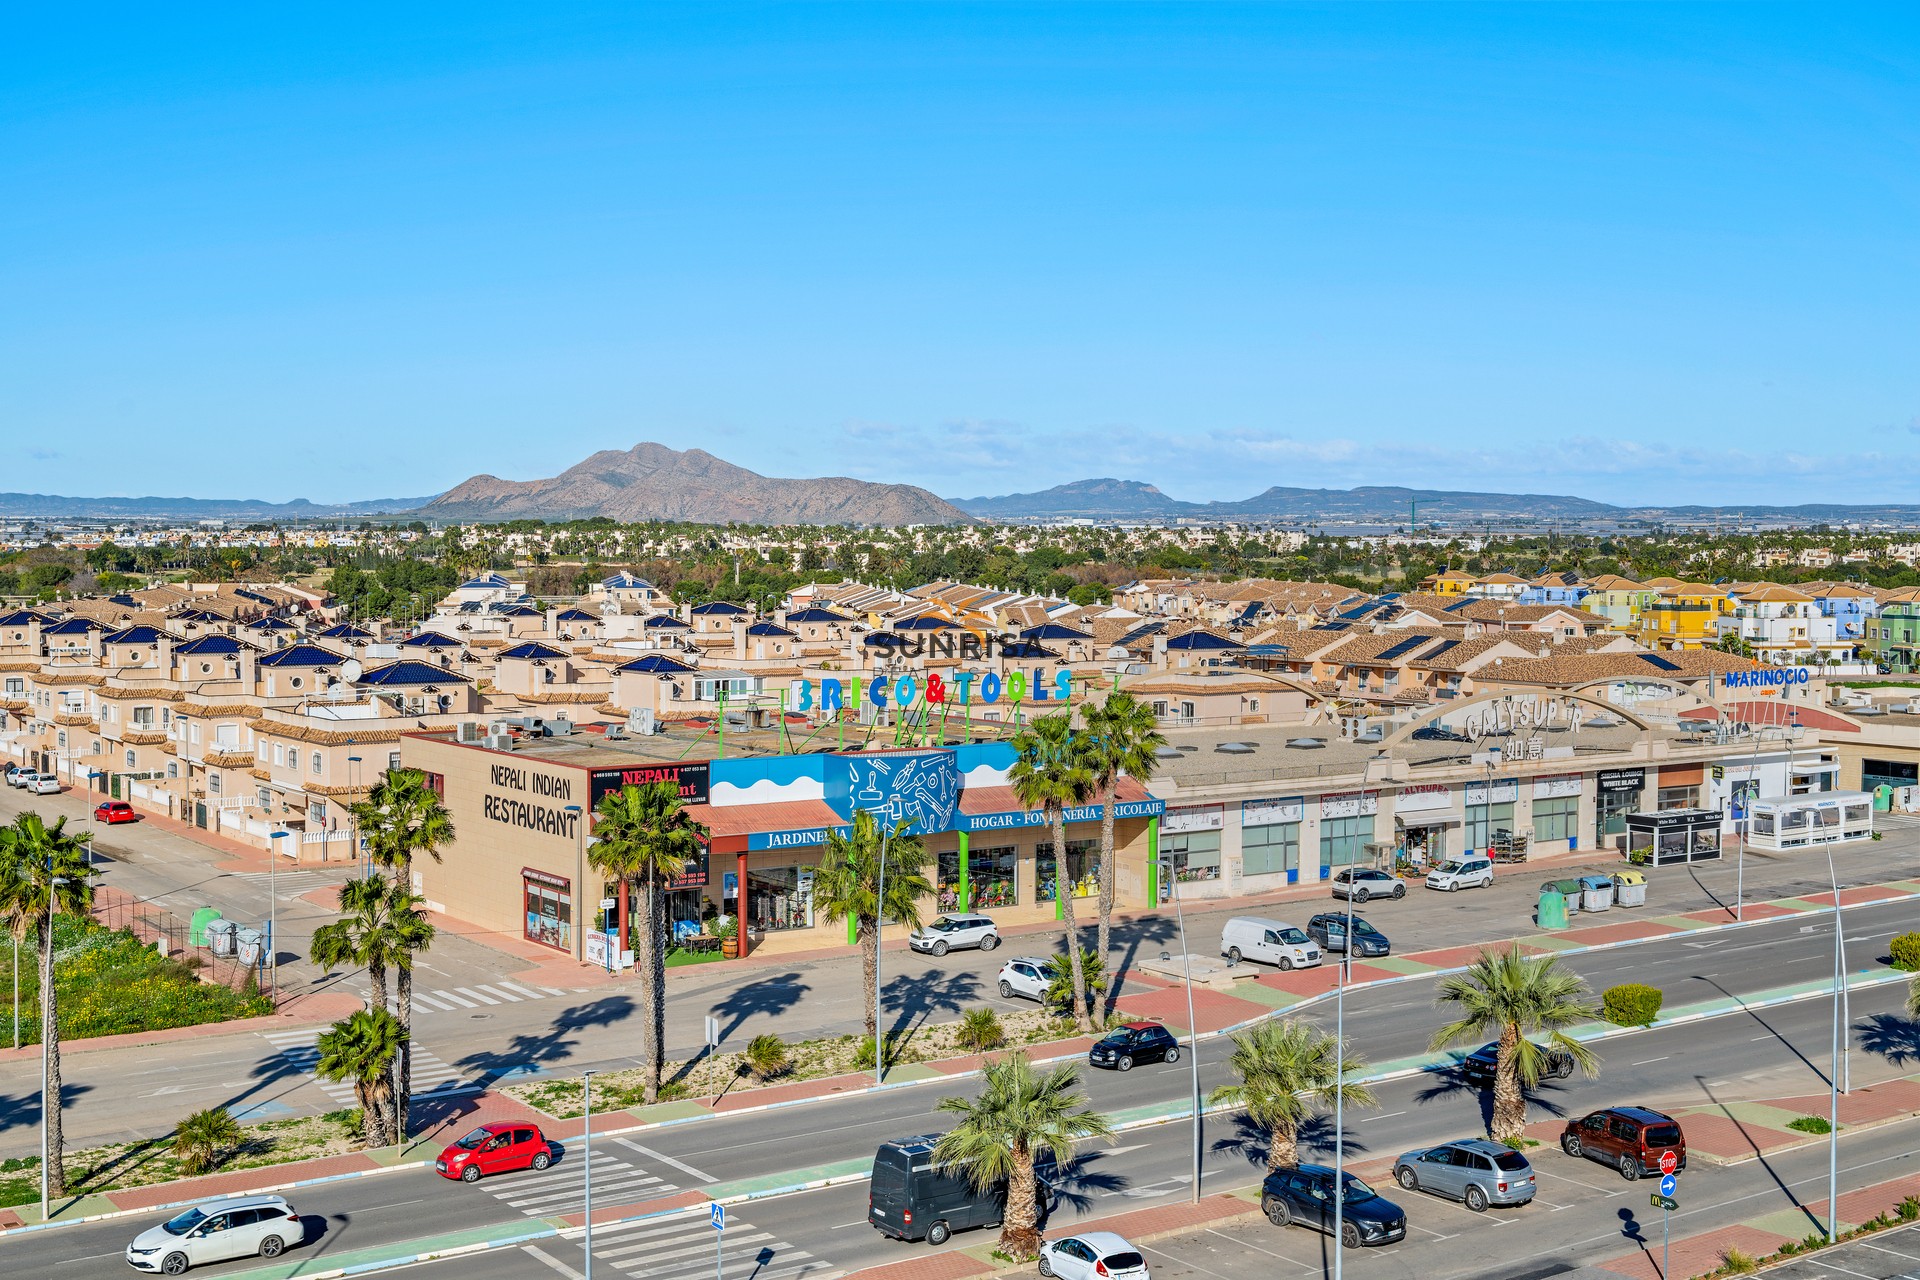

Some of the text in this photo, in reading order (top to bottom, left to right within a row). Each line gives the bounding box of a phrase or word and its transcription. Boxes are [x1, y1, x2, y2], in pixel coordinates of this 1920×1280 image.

[1726, 667, 1809, 688] MARINOCIO
[1506, 737, 1544, 762] 如意
[491, 764, 571, 800] NEPALI INDIAN
[622, 768, 680, 785] NEPALI
[484, 794, 578, 839] RESTAURANT
[970, 802, 1162, 829] HOGAR FONNERÍA RICOLAJE
[1661, 1158, 1676, 1169] STOP
